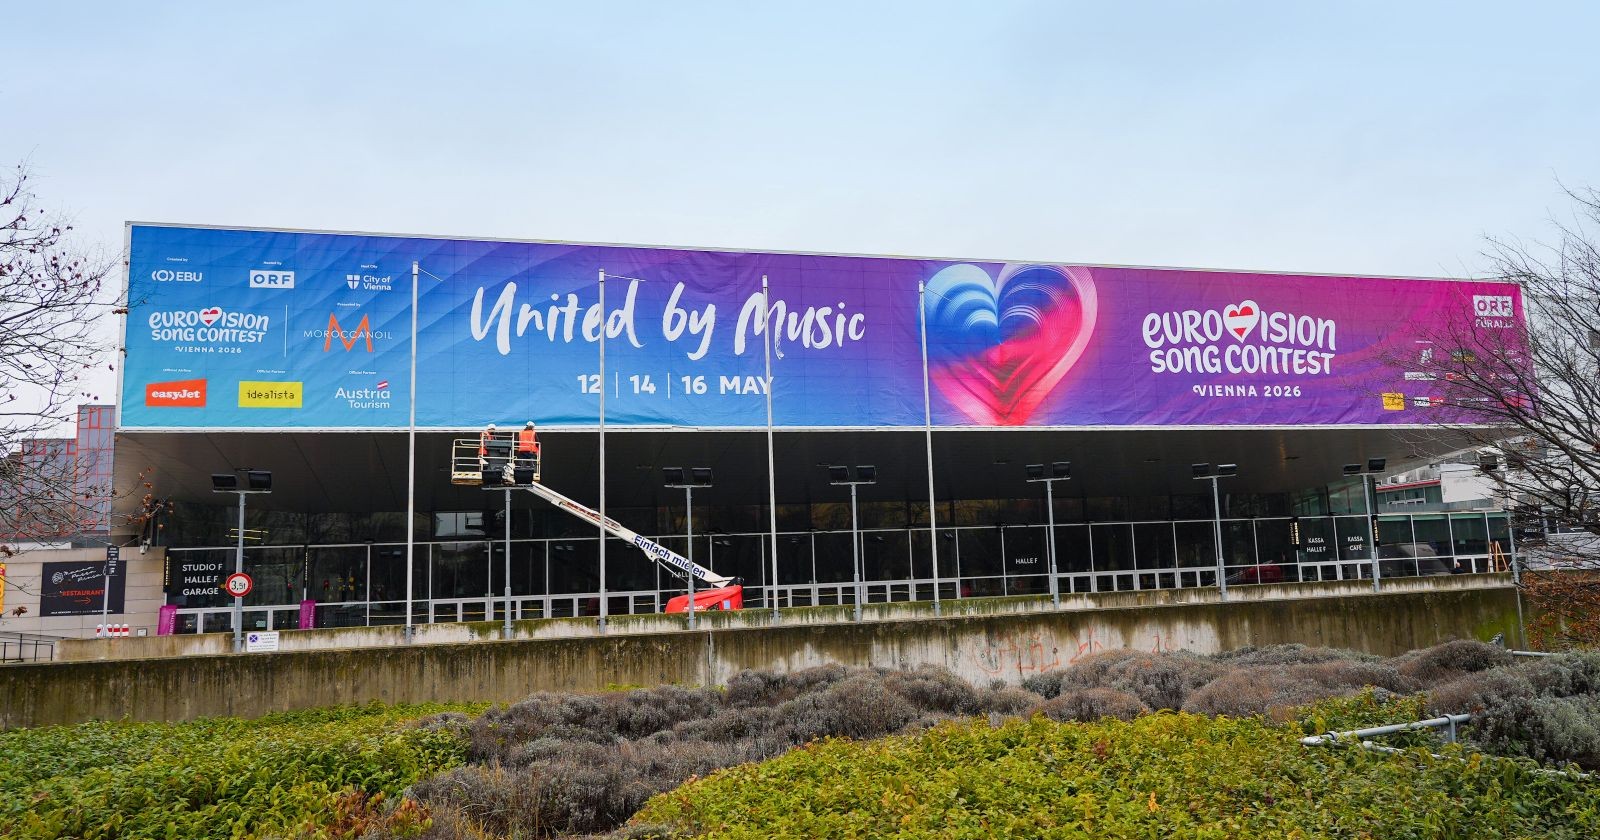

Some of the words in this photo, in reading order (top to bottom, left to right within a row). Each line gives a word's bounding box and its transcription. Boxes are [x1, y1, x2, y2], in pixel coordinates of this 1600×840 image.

[176, 271, 203, 282] EBU
[253, 273, 291, 285] ORF
[363, 275, 380, 284] City
[381, 275, 391, 283] of
[363, 282, 392, 291] Vienna
[1477, 300, 1509, 313] ORF
[470, 279, 648, 356] United
[662, 281, 716, 361] by
[734, 291, 866, 360] Music
[151, 328, 195, 342] SONG
[196, 328, 267, 343] CONTEST
[303, 329, 393, 340] MOROCCANOIL
[1150, 344, 1222, 374] SONG
[1224, 344, 1336, 375] CONTEST
[577, 374, 603, 394] 12
[629, 375, 656, 394] 14
[681, 375, 708, 395] 16
[719, 376, 775, 396] MAY
[1192, 384, 1258, 397] VIENNA
[1263, 385, 1302, 397] 2026
[151, 389, 201, 400] easyJet
[247, 389, 295, 400] idealista
[335, 387, 391, 399] Austria
[348, 399, 390, 409] Tourism
[634, 535, 671, 560] Einfach
[672, 556, 706, 579] mieen
[1015, 557, 1033, 565] HALLE
[182, 563, 216, 572] STUDIO
[218, 563, 223, 571] F
[184, 575, 211, 584] HALLE
[213, 575, 218, 583] F
[231, 580, 246, 591] 3,5t
[182, 587, 219, 596] GARAGE
